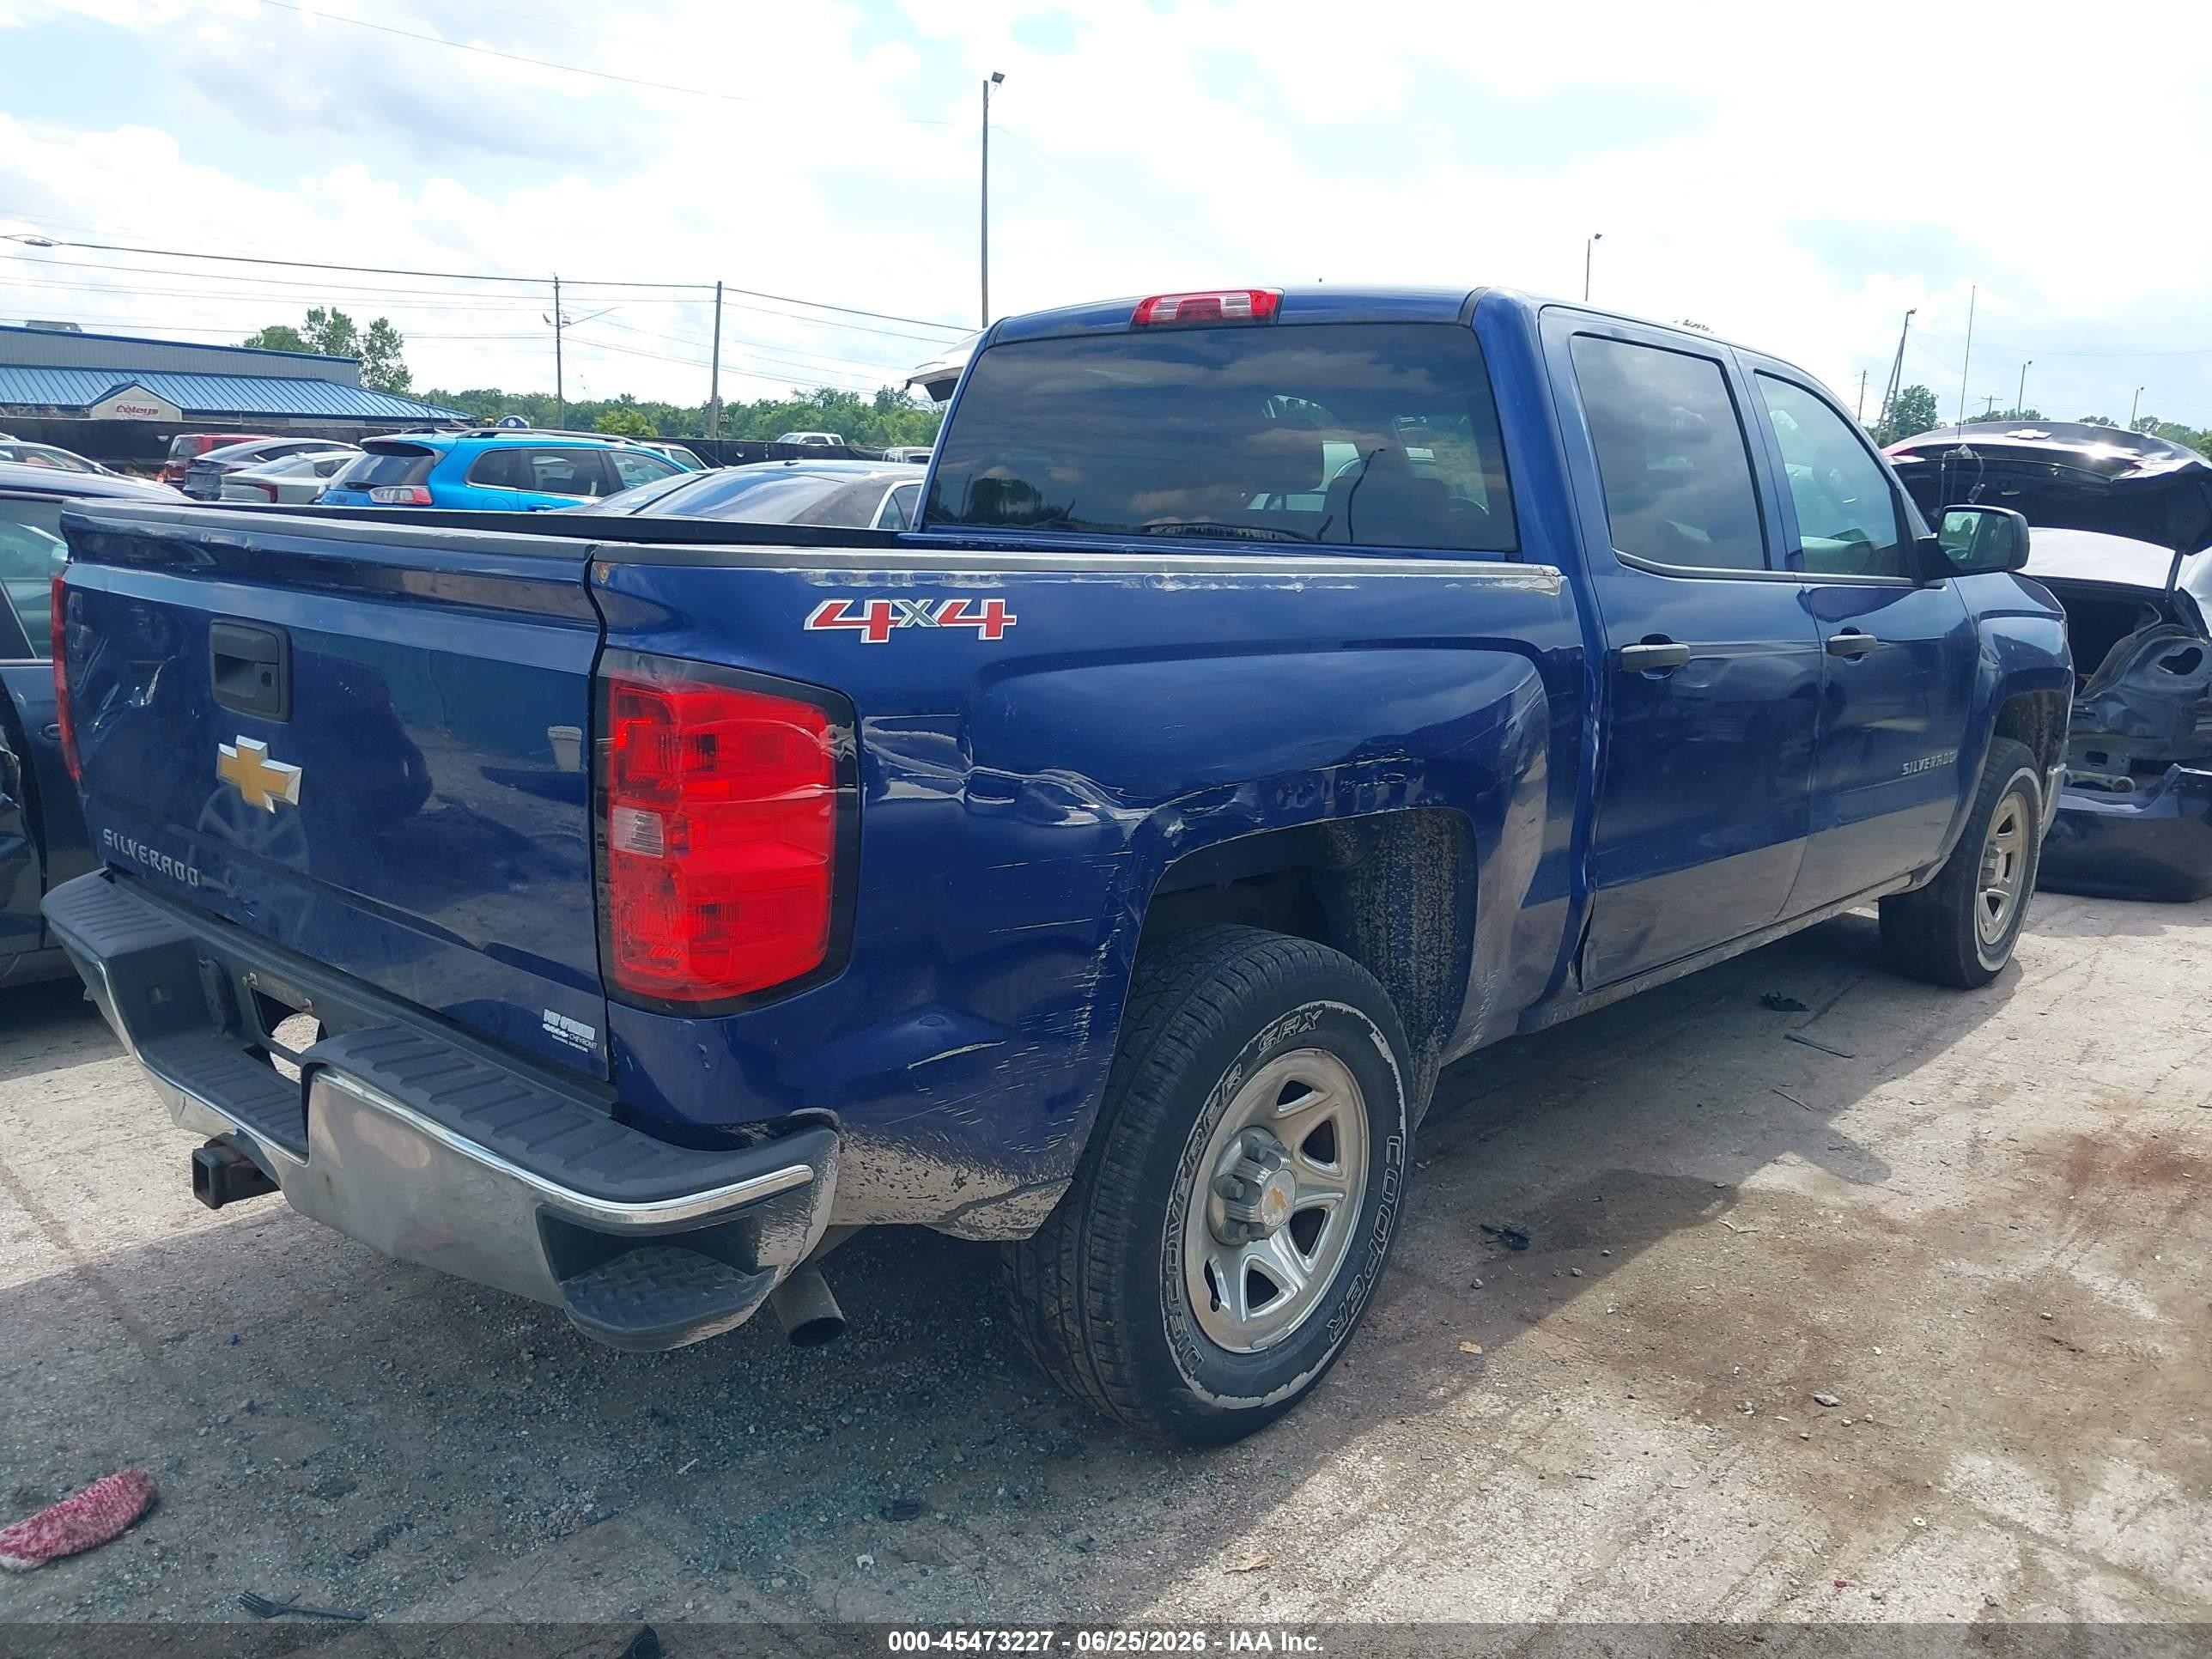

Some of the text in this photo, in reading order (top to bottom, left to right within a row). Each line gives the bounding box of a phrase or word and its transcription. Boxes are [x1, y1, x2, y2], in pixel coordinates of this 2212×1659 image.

[1901, 751, 1956, 775] SILVERADO
[103, 828, 198, 887] SILVERADO
[568, 1033, 598, 1049] CHEVROLET
[1258, 1009, 1323, 1052] SRX
[1326, 1135, 1401, 1343] COOPER
